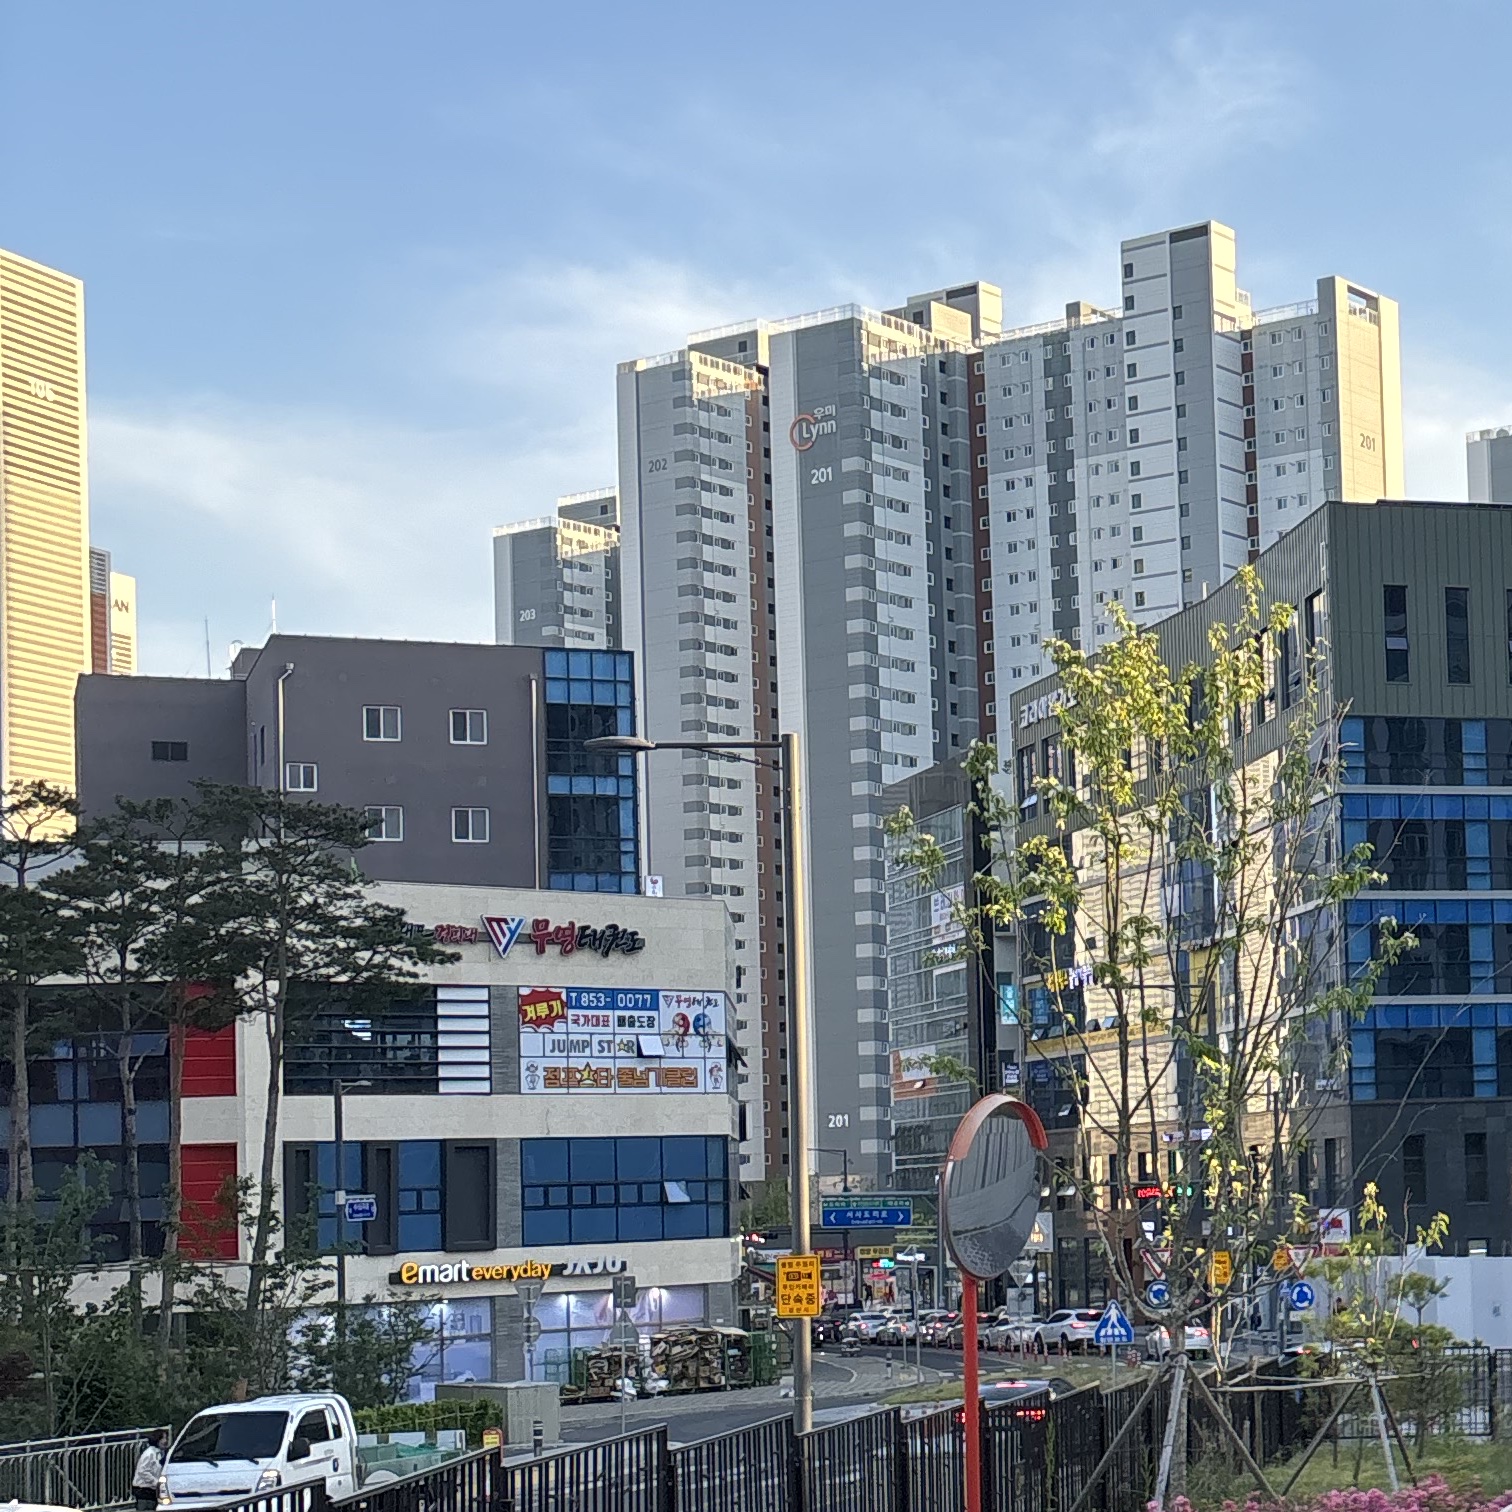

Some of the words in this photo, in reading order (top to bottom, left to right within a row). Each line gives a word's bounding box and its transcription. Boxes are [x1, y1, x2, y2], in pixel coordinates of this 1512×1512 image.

[813, 404, 836, 419] 우미
[802, 418, 837, 440] Lynn
[1360, 433, 1376, 452] 201
[648, 458, 668, 473] 202
[811, 466, 833, 485] 201
[519, 608, 536, 622] 203
[522, 1000, 563, 1022] 겨루기
[571, 1014, 610, 1028] 국가대표
[550, 1039, 590, 1054] JUMP
[617, 1067, 698, 1088] 줄넘기클럽
[828, 1114, 849, 1128] 201
[401, 1259, 470, 1284] emart
[472, 1259, 552, 1282] everyday
[781, 1293, 816, 1305] 단속중
